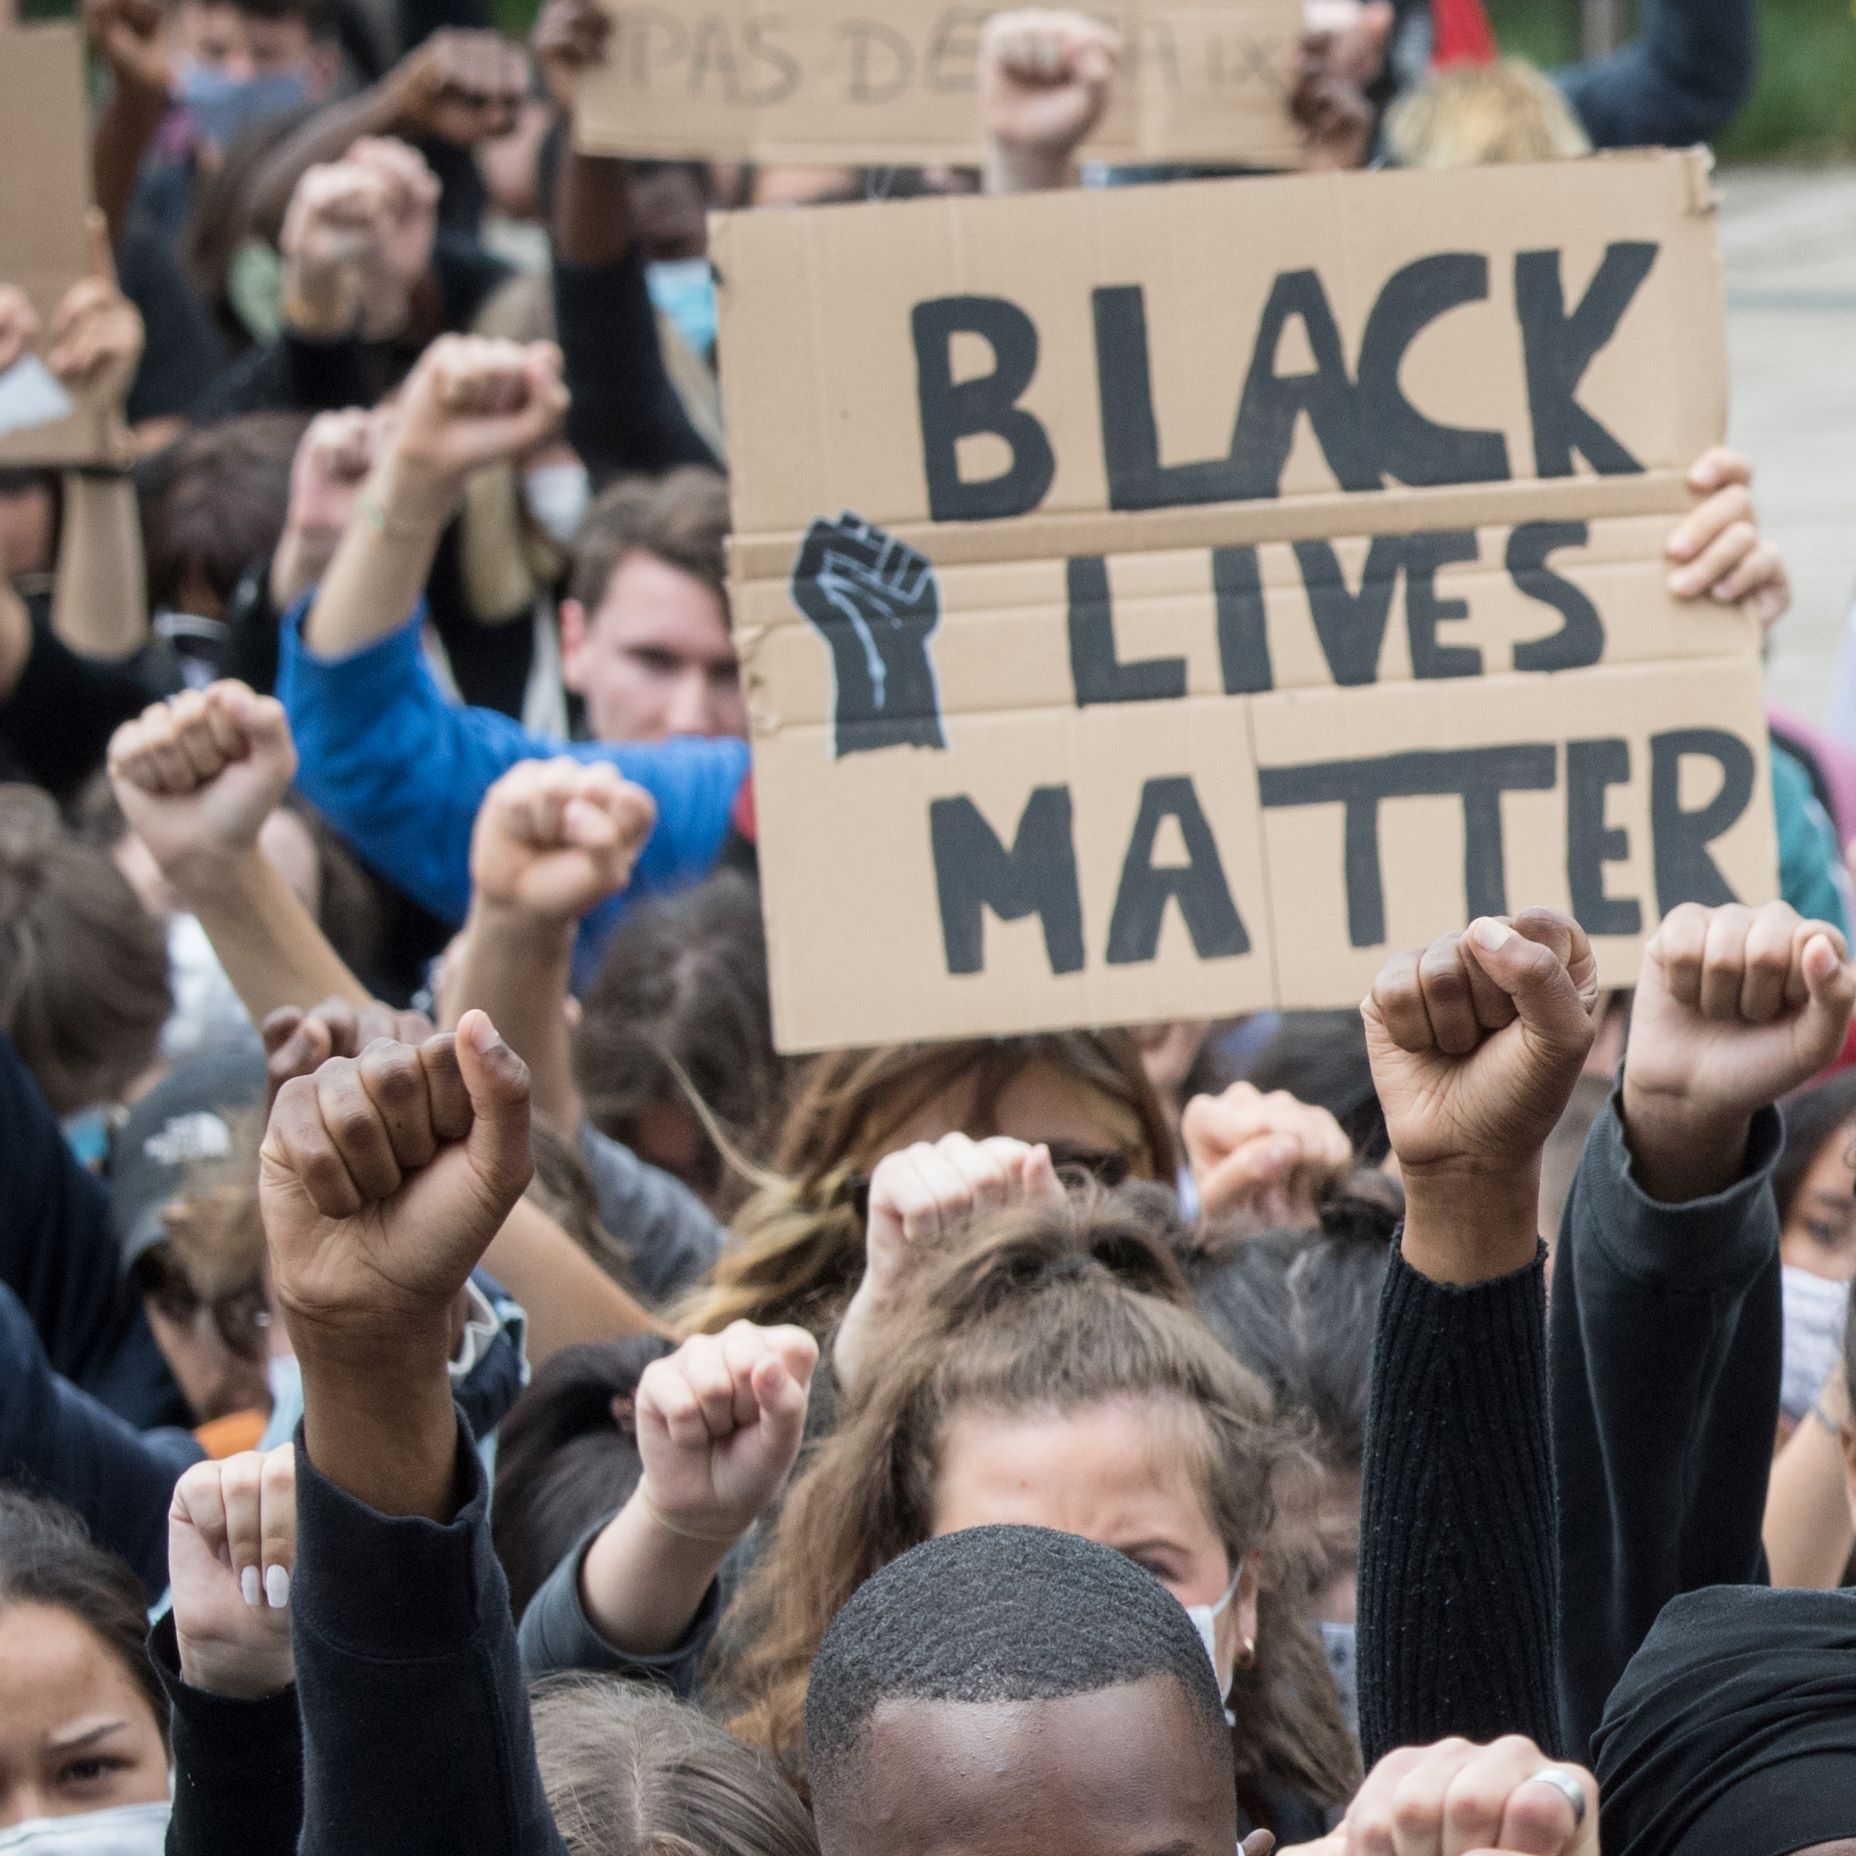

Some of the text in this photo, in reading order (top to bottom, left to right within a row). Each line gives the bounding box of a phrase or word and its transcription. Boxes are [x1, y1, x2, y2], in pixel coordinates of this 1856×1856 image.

[911, 241, 1659, 524] BLACK
[1066, 520, 1602, 709] LIVES
[929, 728, 1755, 975] MATTER
